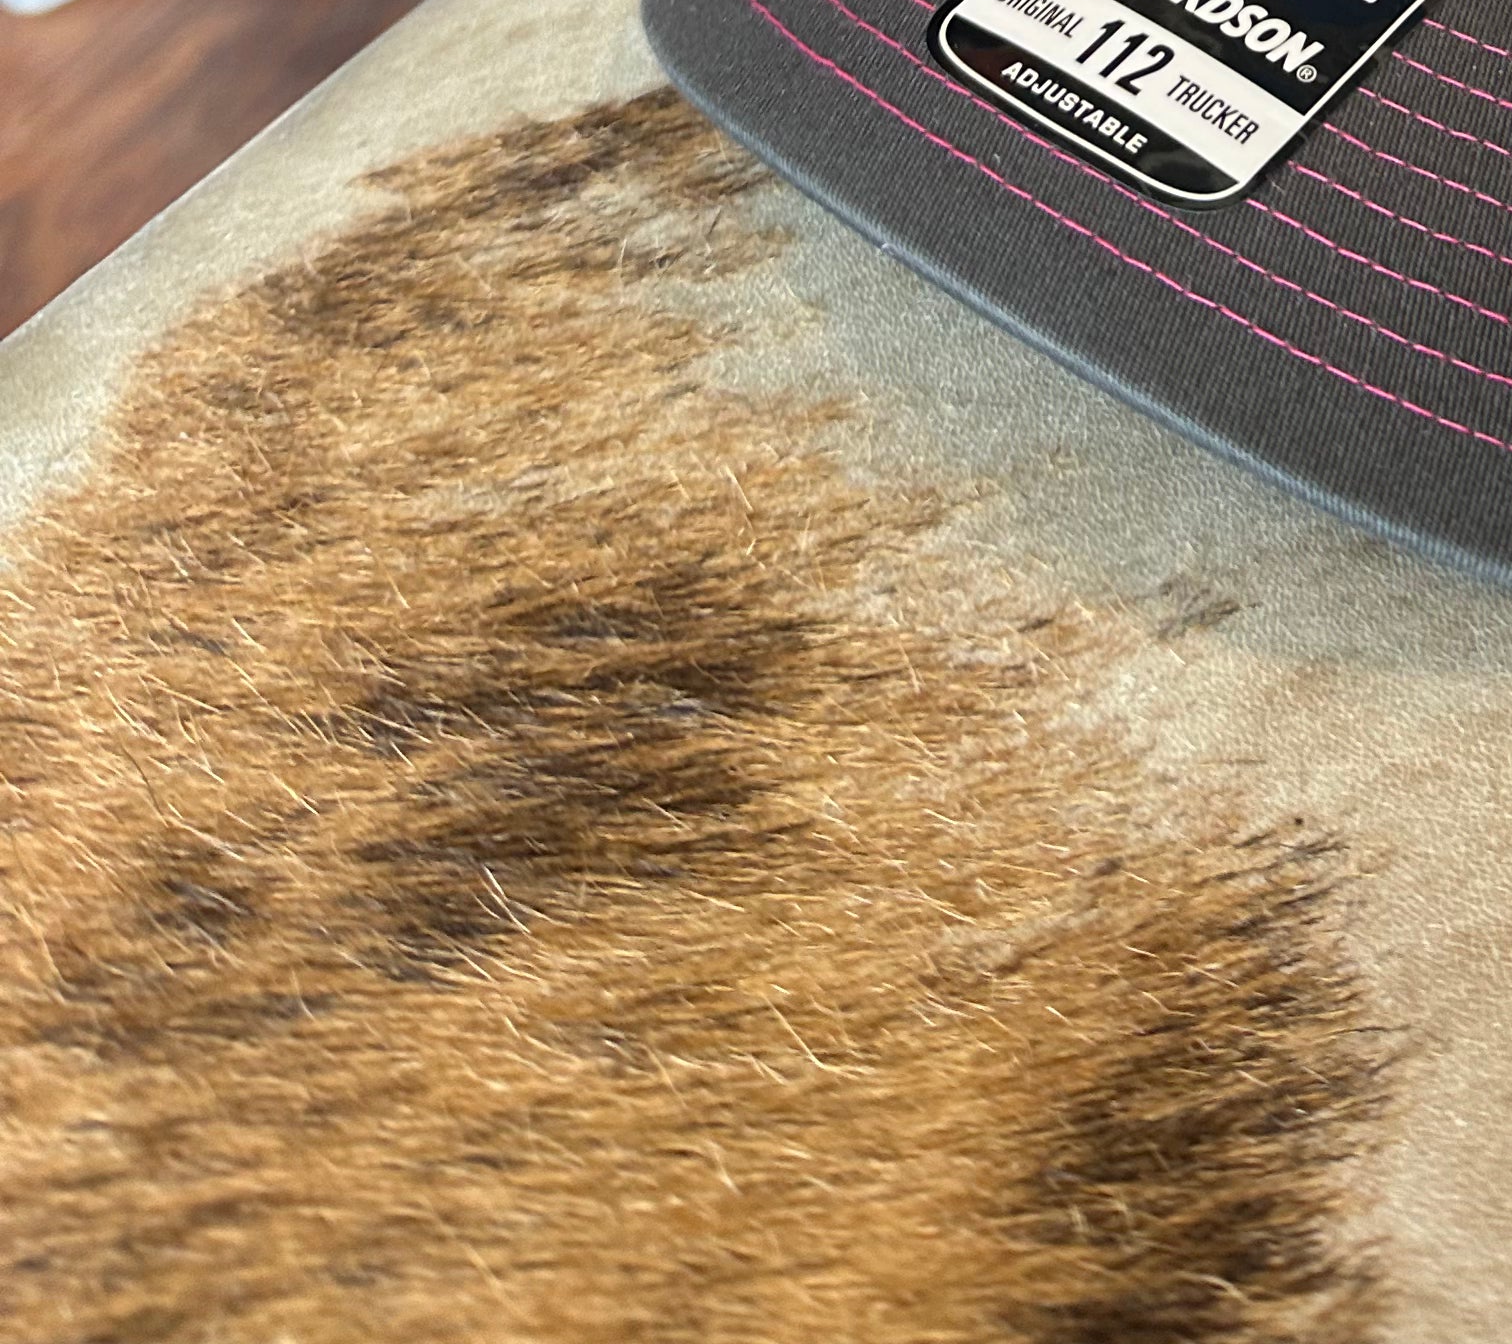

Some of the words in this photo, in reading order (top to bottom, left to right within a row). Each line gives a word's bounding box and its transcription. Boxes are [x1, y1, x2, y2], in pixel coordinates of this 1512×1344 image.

[1001, 61, 1148, 154] ADJUSTABLE
[1074, 18, 1175, 97] 112
[1167, 75, 1259, 145] TRUCKER
